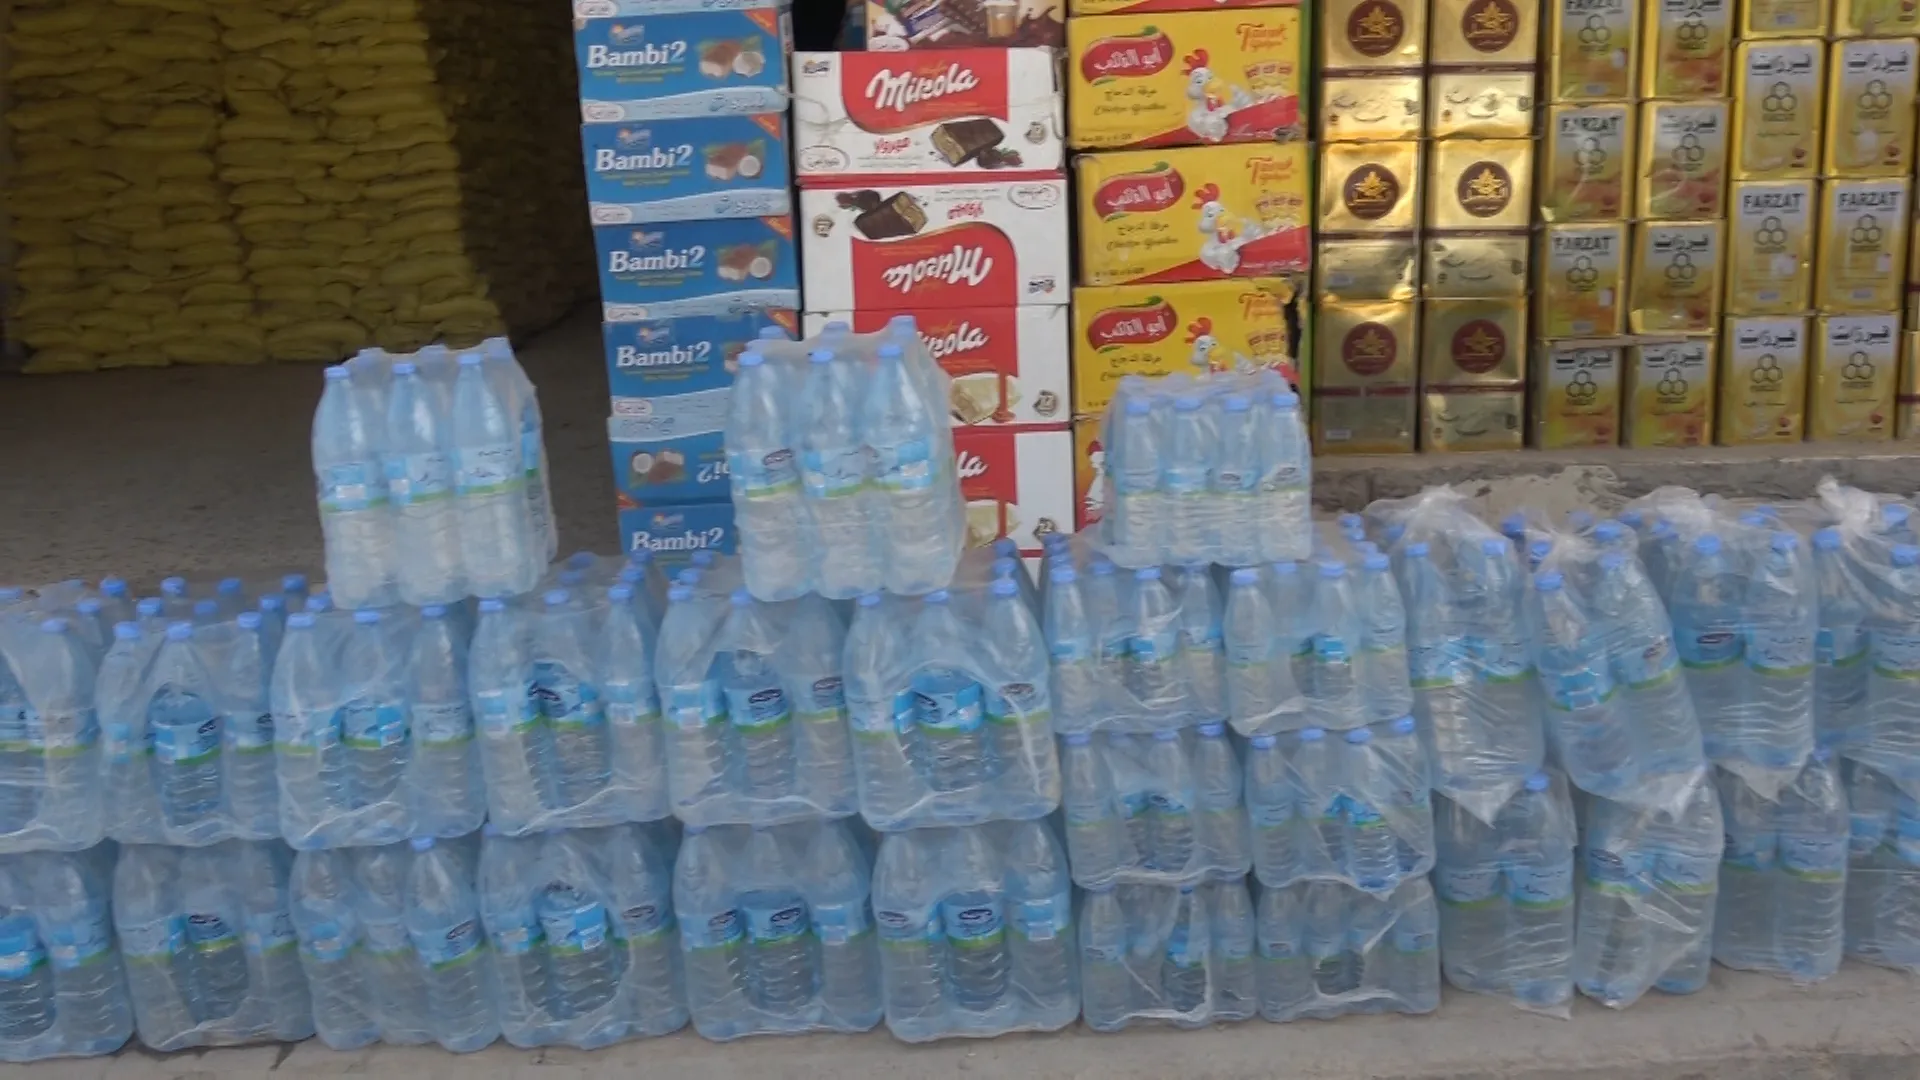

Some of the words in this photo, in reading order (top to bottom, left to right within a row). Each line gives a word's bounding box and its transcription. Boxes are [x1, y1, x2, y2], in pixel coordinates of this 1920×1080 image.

[586, 40, 687, 69] Bambi2
[1560, 116, 1622, 132] FARZAT
[594, 144, 694, 172] Bambi2
[1743, 192, 1805, 208] FARZAT
[1839, 190, 1904, 207] FARZAT
[1552, 235, 1616, 250] FARZAT
[608, 245, 706, 273] Bambi2
[615, 341, 711, 368] Bambi2
[630, 526, 725, 551] Bambi2
